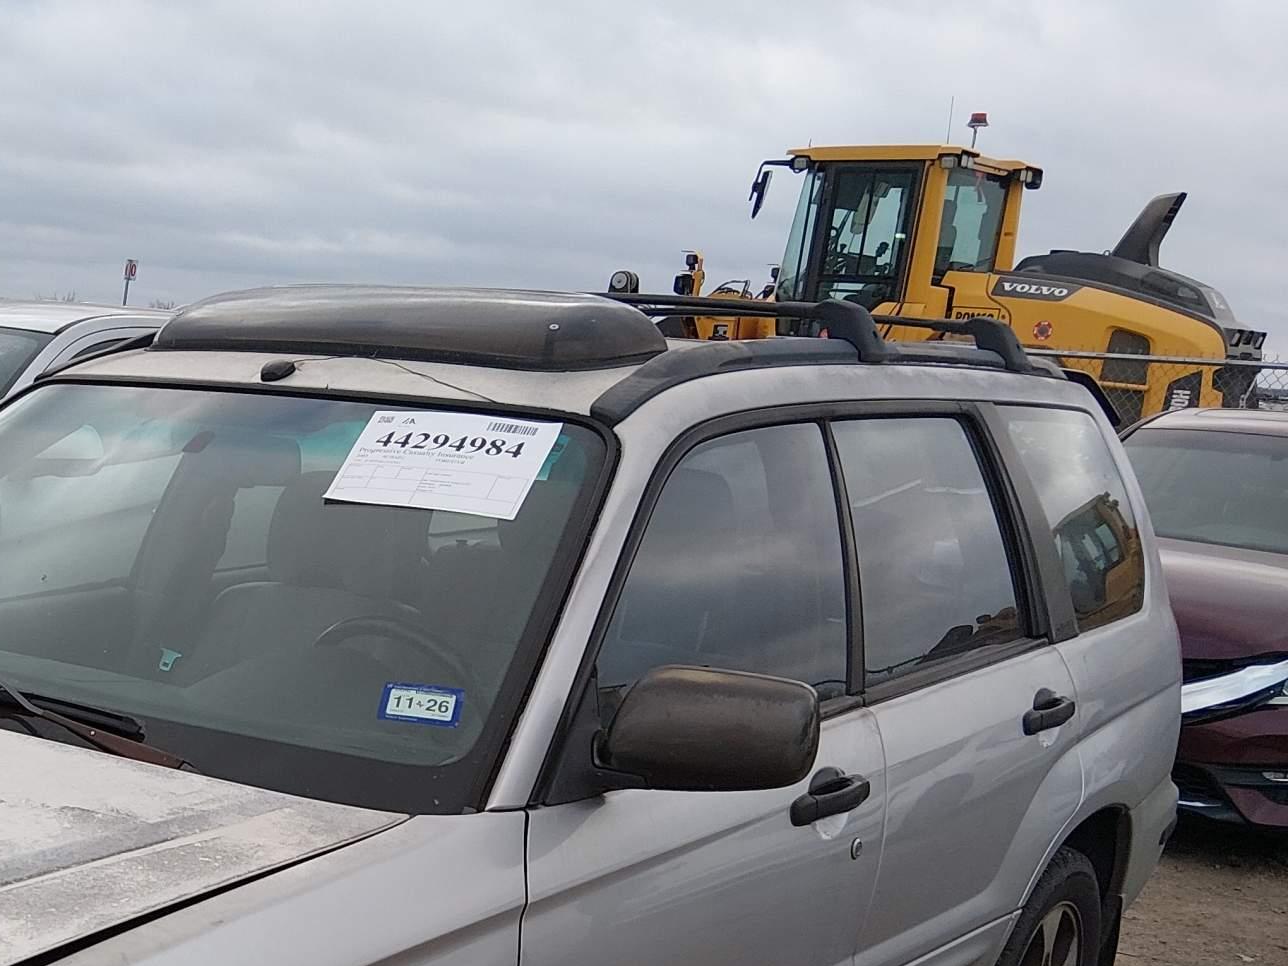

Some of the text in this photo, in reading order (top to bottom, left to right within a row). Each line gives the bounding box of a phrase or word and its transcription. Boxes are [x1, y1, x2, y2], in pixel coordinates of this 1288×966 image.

[1002, 282, 1068, 297] VOLVO
[376, 430, 526, 458] 44294984
[425, 698, 450, 714] 26
